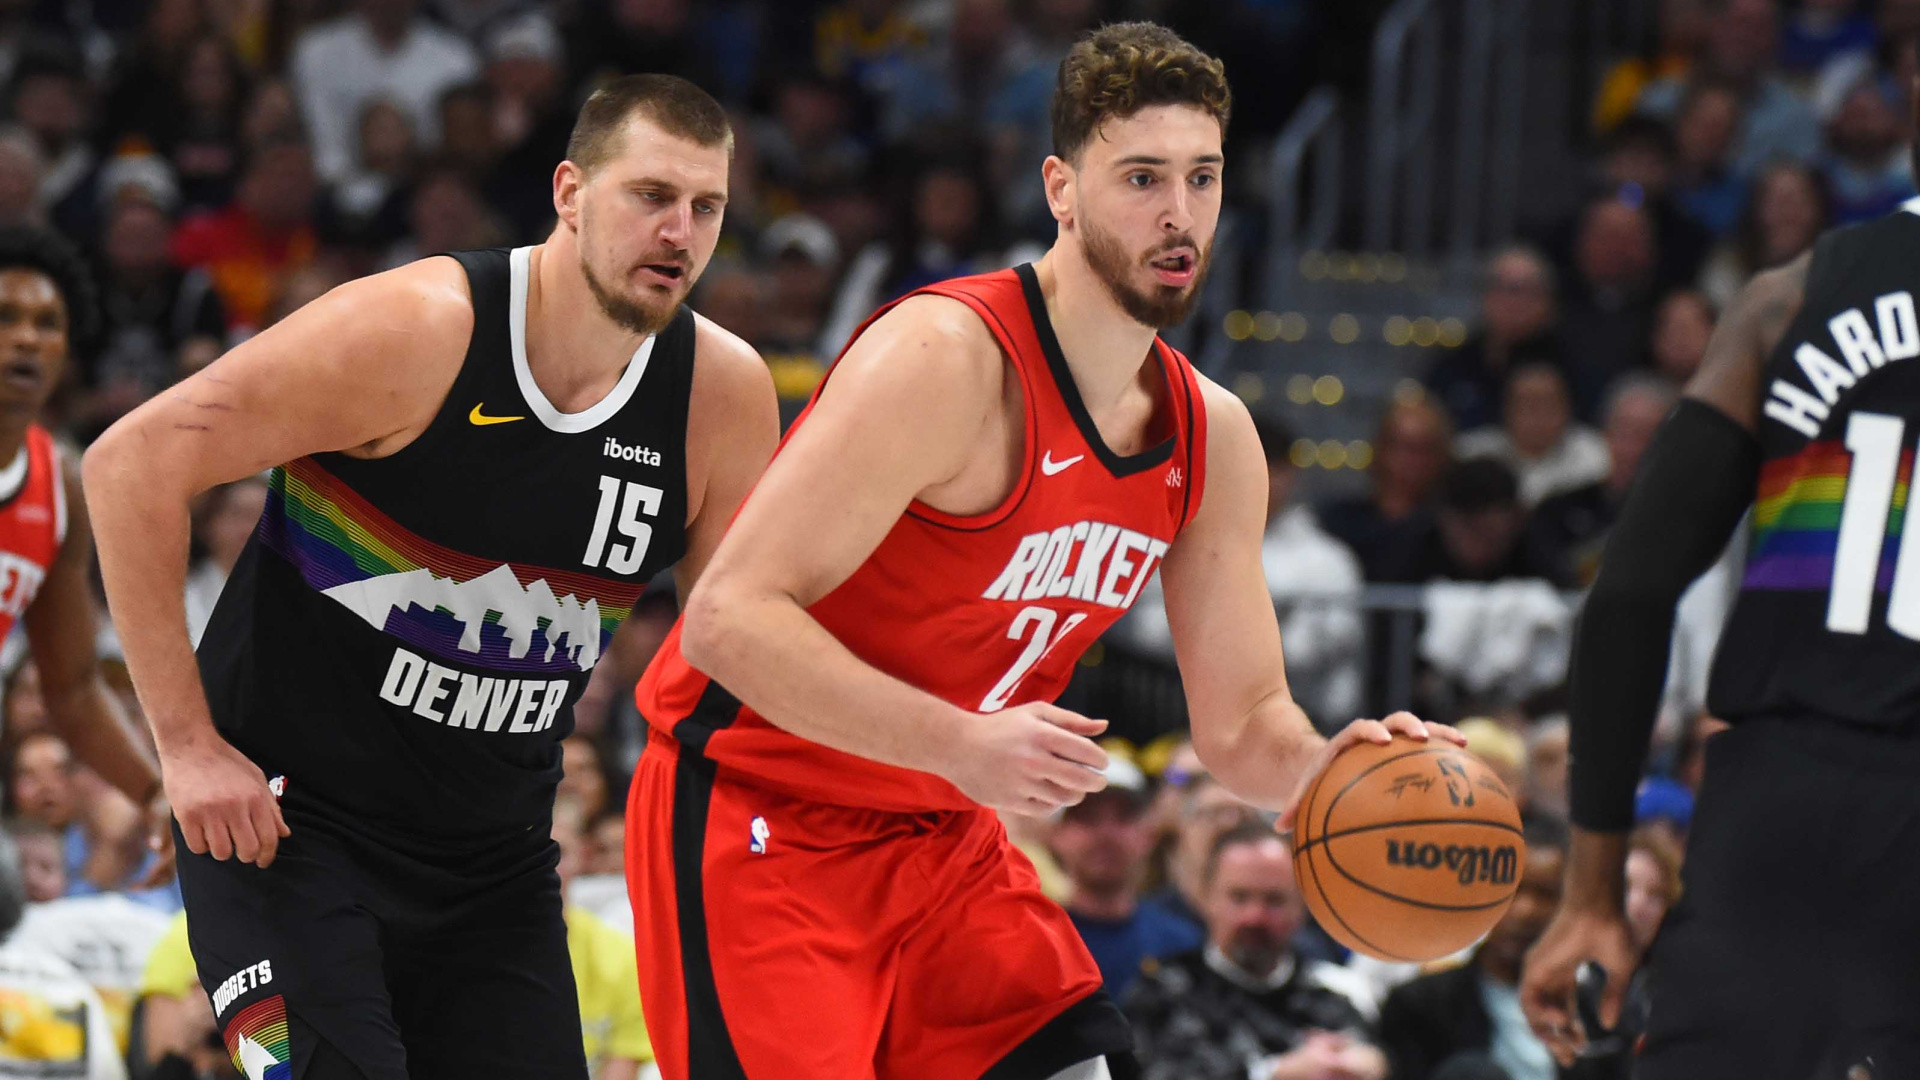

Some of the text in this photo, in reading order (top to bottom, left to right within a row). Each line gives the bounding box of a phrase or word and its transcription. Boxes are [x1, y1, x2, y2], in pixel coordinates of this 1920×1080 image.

[603, 436, 662, 467] ibotta
[582, 474, 664, 575] 15
[981, 520, 1170, 609] ROCKET
[379, 647, 569, 733] DENVER
[1386, 838, 1517, 885] Wilson
[212, 959, 273, 1018] NUGGETS
